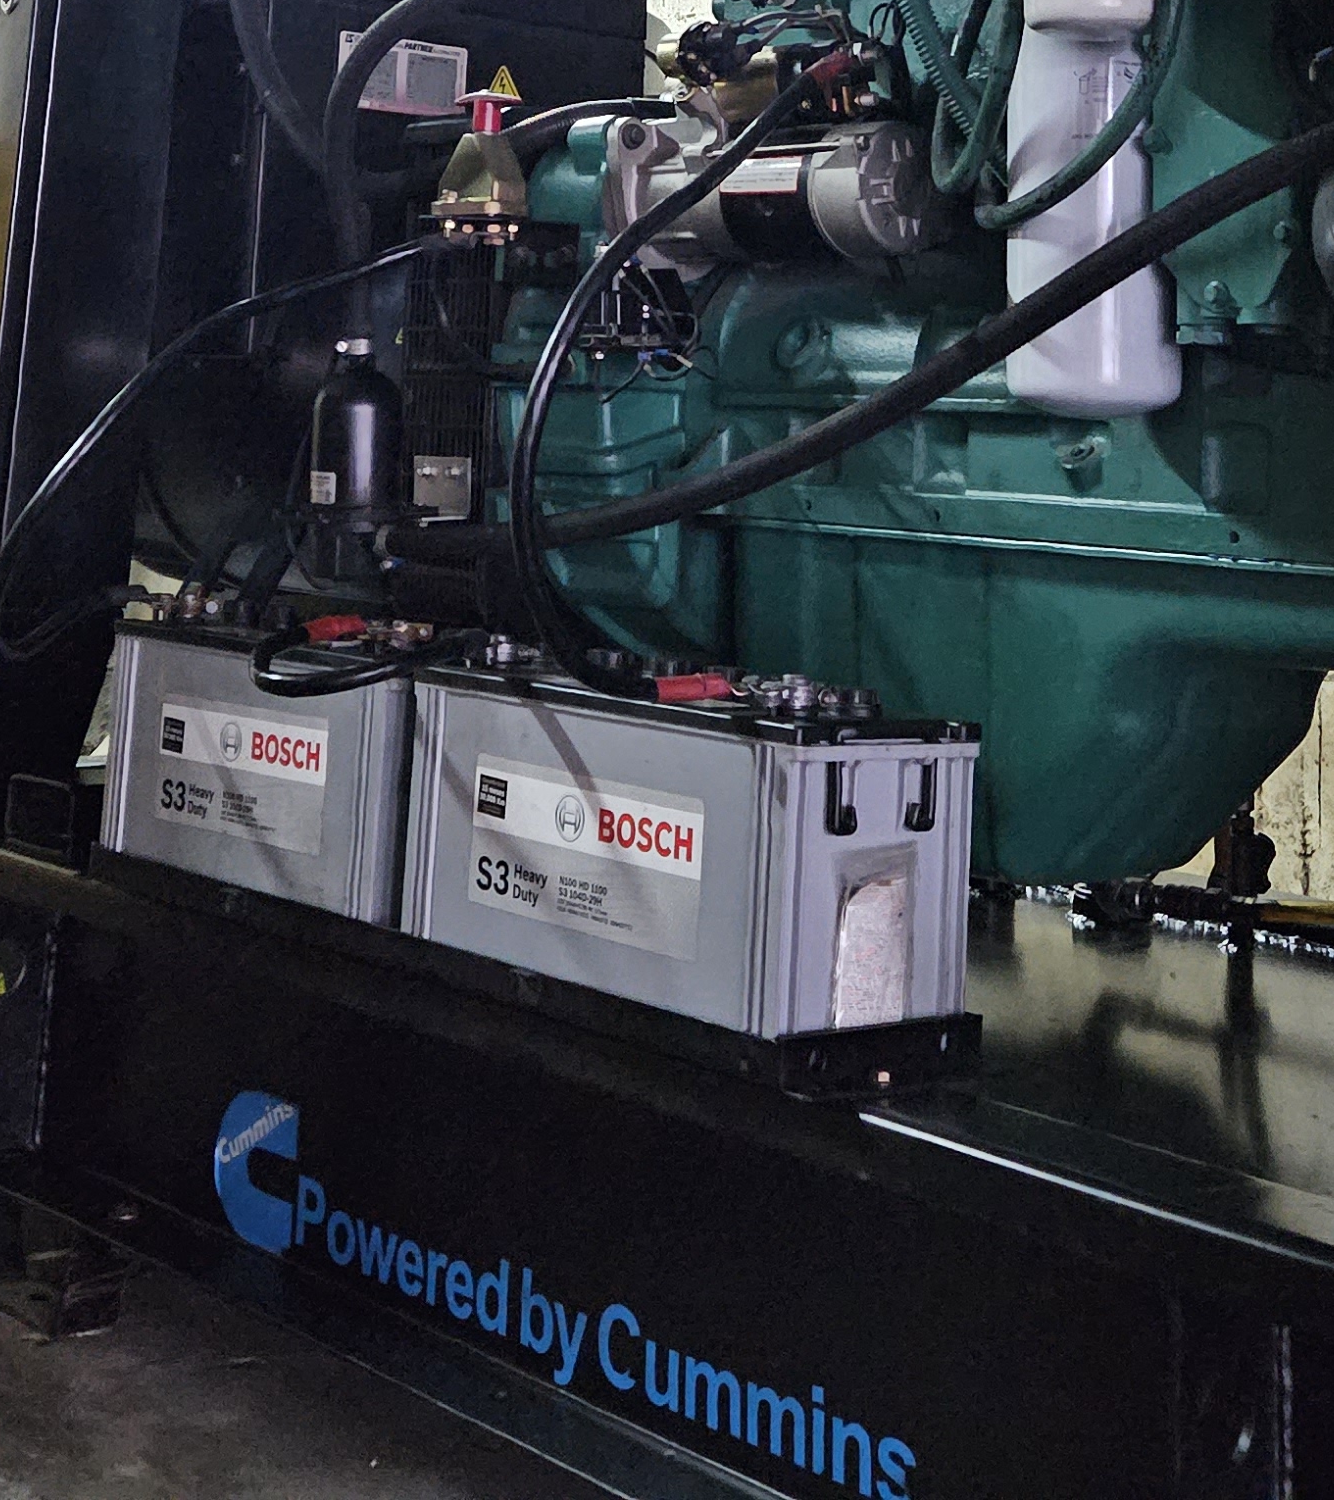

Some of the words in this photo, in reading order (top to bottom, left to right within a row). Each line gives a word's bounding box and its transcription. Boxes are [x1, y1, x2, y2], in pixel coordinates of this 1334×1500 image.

[251, 731, 320, 772] BOSCH
[161, 778, 186, 812] S3
[188, 784, 215, 803] Heavy
[186, 800, 208, 819] Duty
[598, 807, 694, 863] BOSCH
[476, 855, 510, 896] S3
[514, 863, 548, 888] Heavy
[558, 875, 577, 888] N100
[578, 880, 590, 891] HD
[512, 883, 539, 908] Duty
[558, 887, 568, 897] S3
[218, 1102, 295, 1164] Cummins
[295, 1174, 511, 1336] Powered
[520, 1267, 587, 1385] by
[598, 1303, 917, 1500] Cummins
